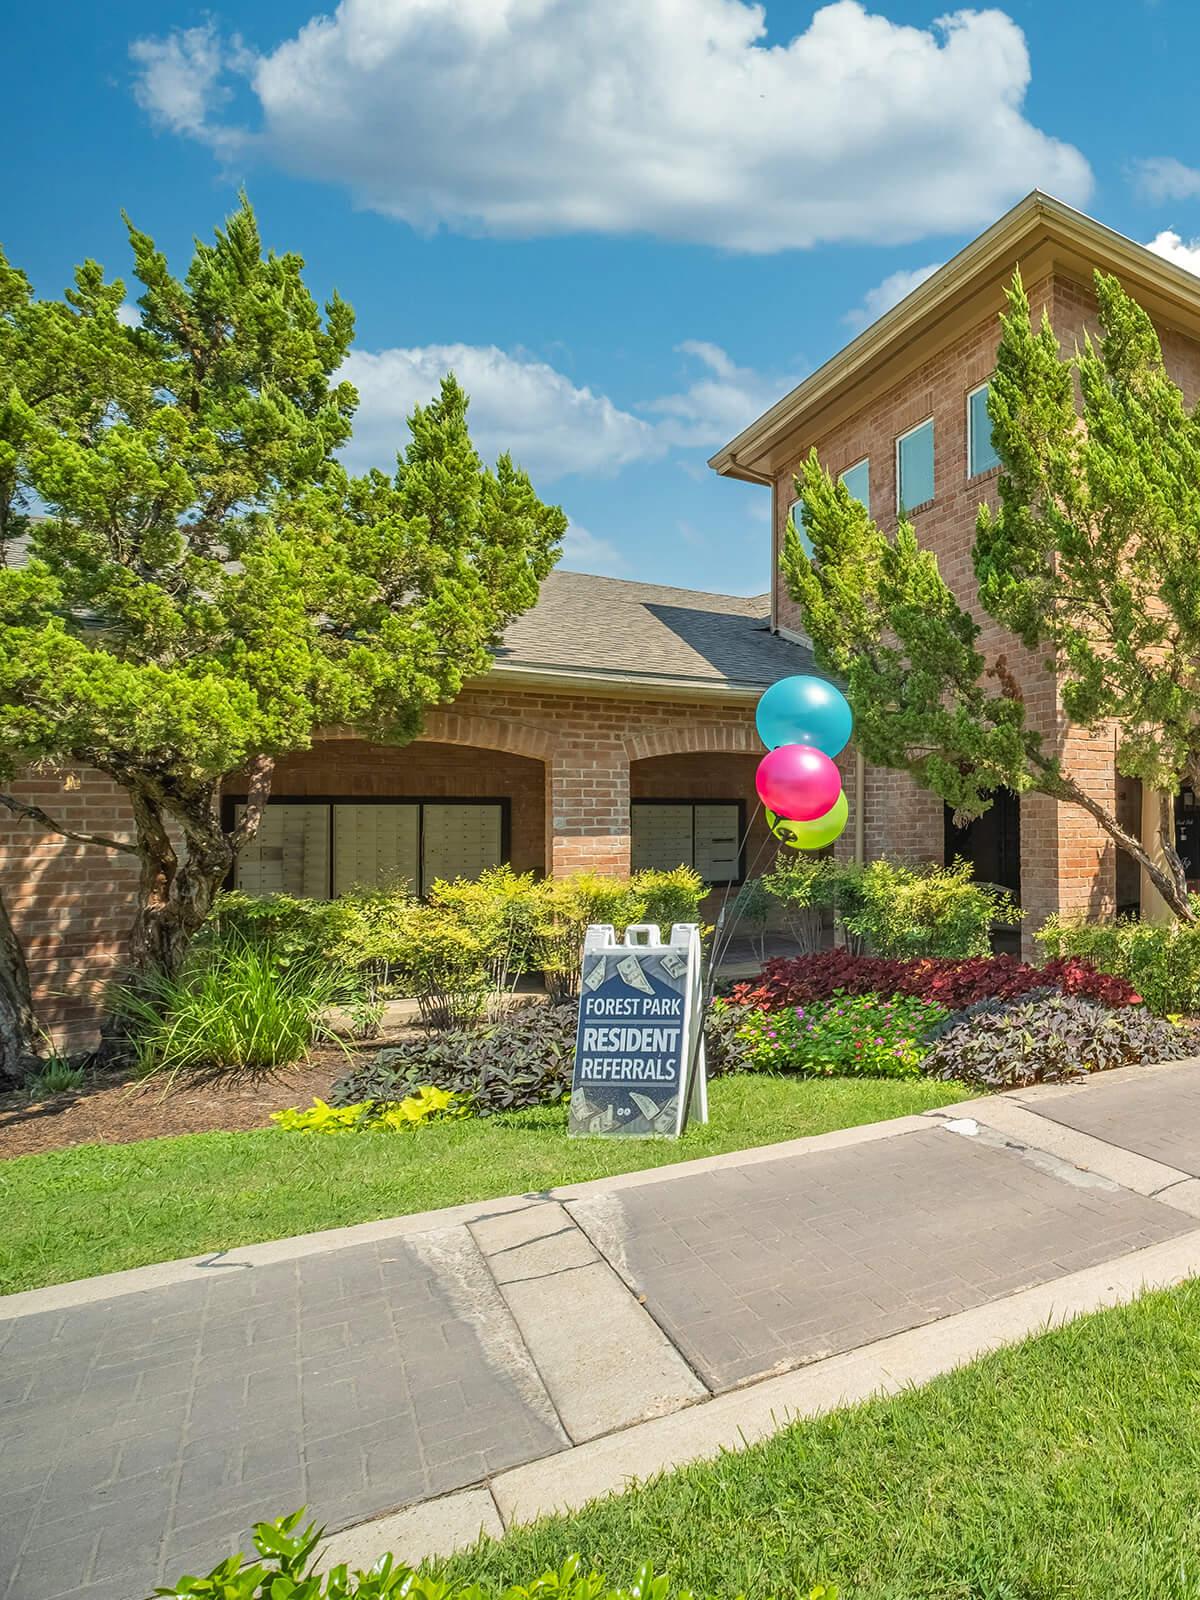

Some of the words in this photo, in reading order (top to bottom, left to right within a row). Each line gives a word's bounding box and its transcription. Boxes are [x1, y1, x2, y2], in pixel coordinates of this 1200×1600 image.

[586, 998, 640, 1016] FOREST
[642, 998, 682, 1016] PARK
[583, 1027, 681, 1053] RESIDENT
[581, 1057, 676, 1081] REFERRALS
